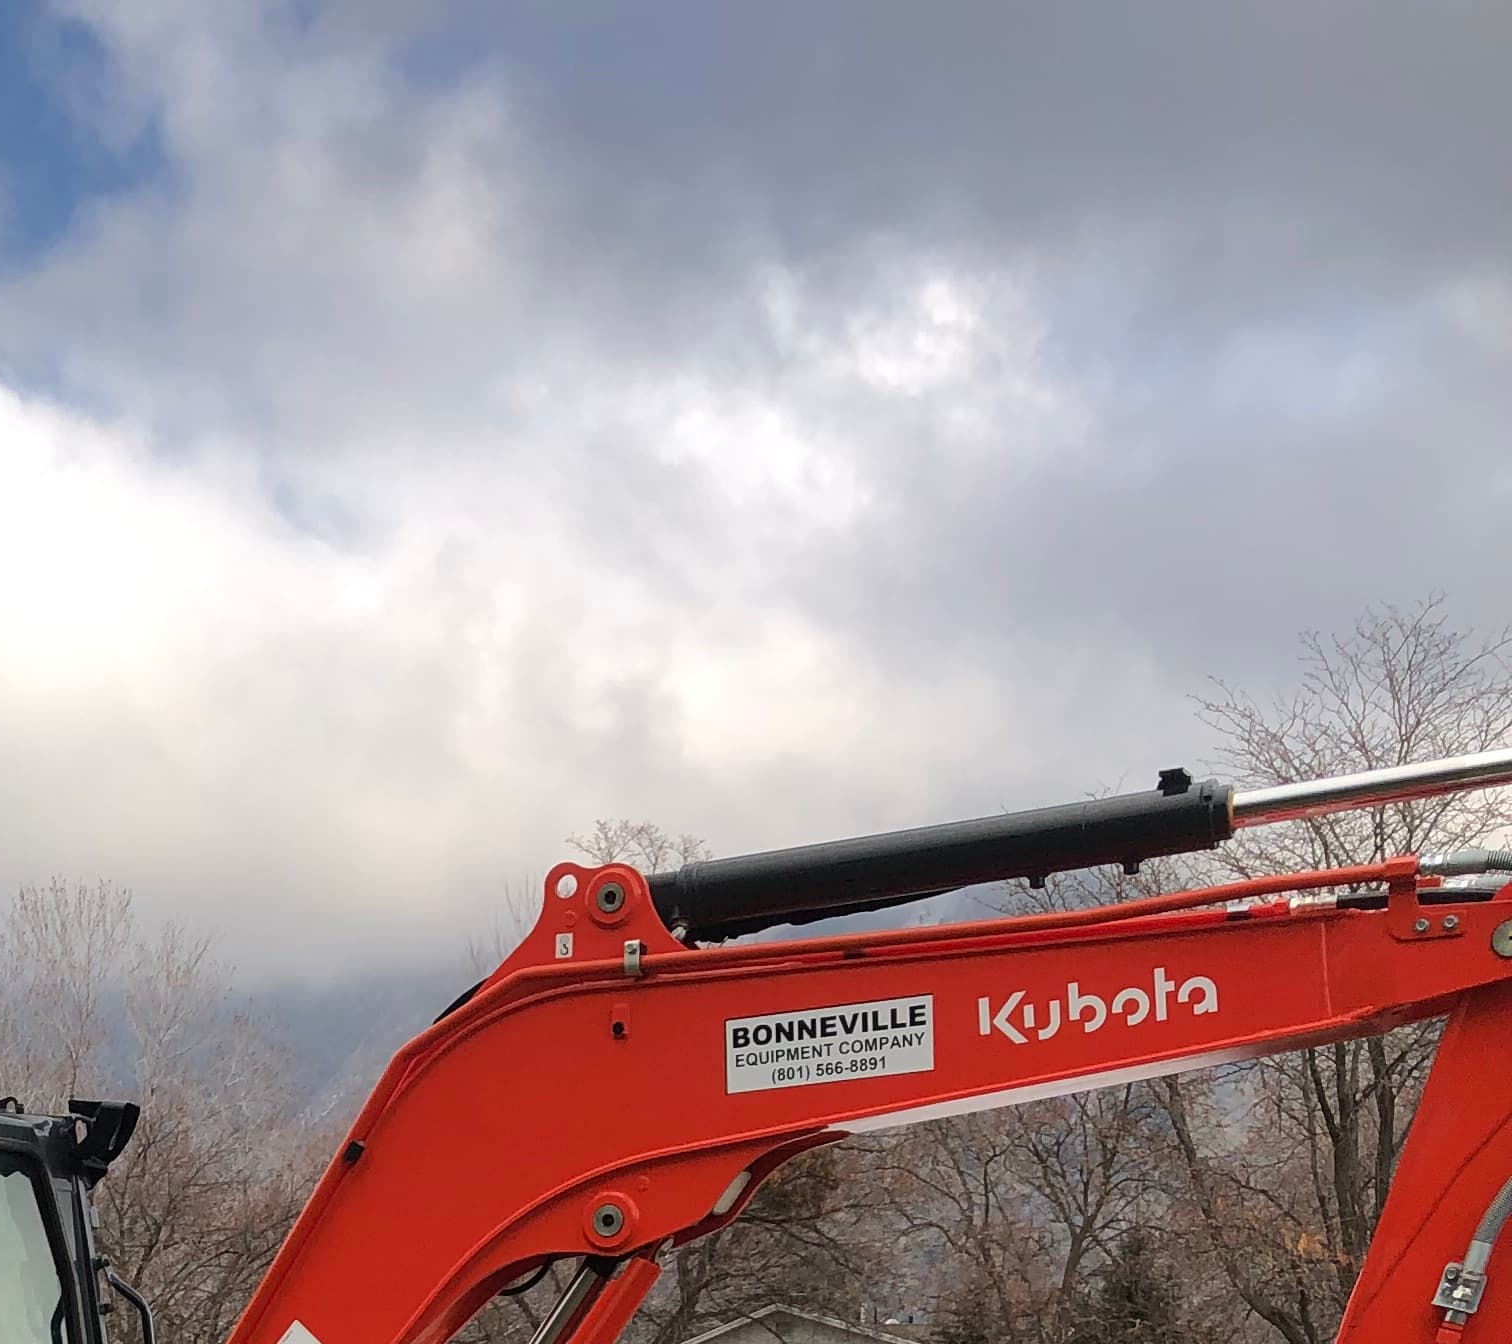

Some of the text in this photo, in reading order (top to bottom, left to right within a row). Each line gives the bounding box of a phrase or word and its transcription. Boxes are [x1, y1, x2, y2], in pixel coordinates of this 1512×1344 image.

[977, 966, 1220, 1045] Kubota
[731, 1004, 927, 1049] BONNEVILLE
[735, 1031, 926, 1068] EQUIPMENT COMPANY
[771, 1055, 887, 1085] (801) 566-8891
